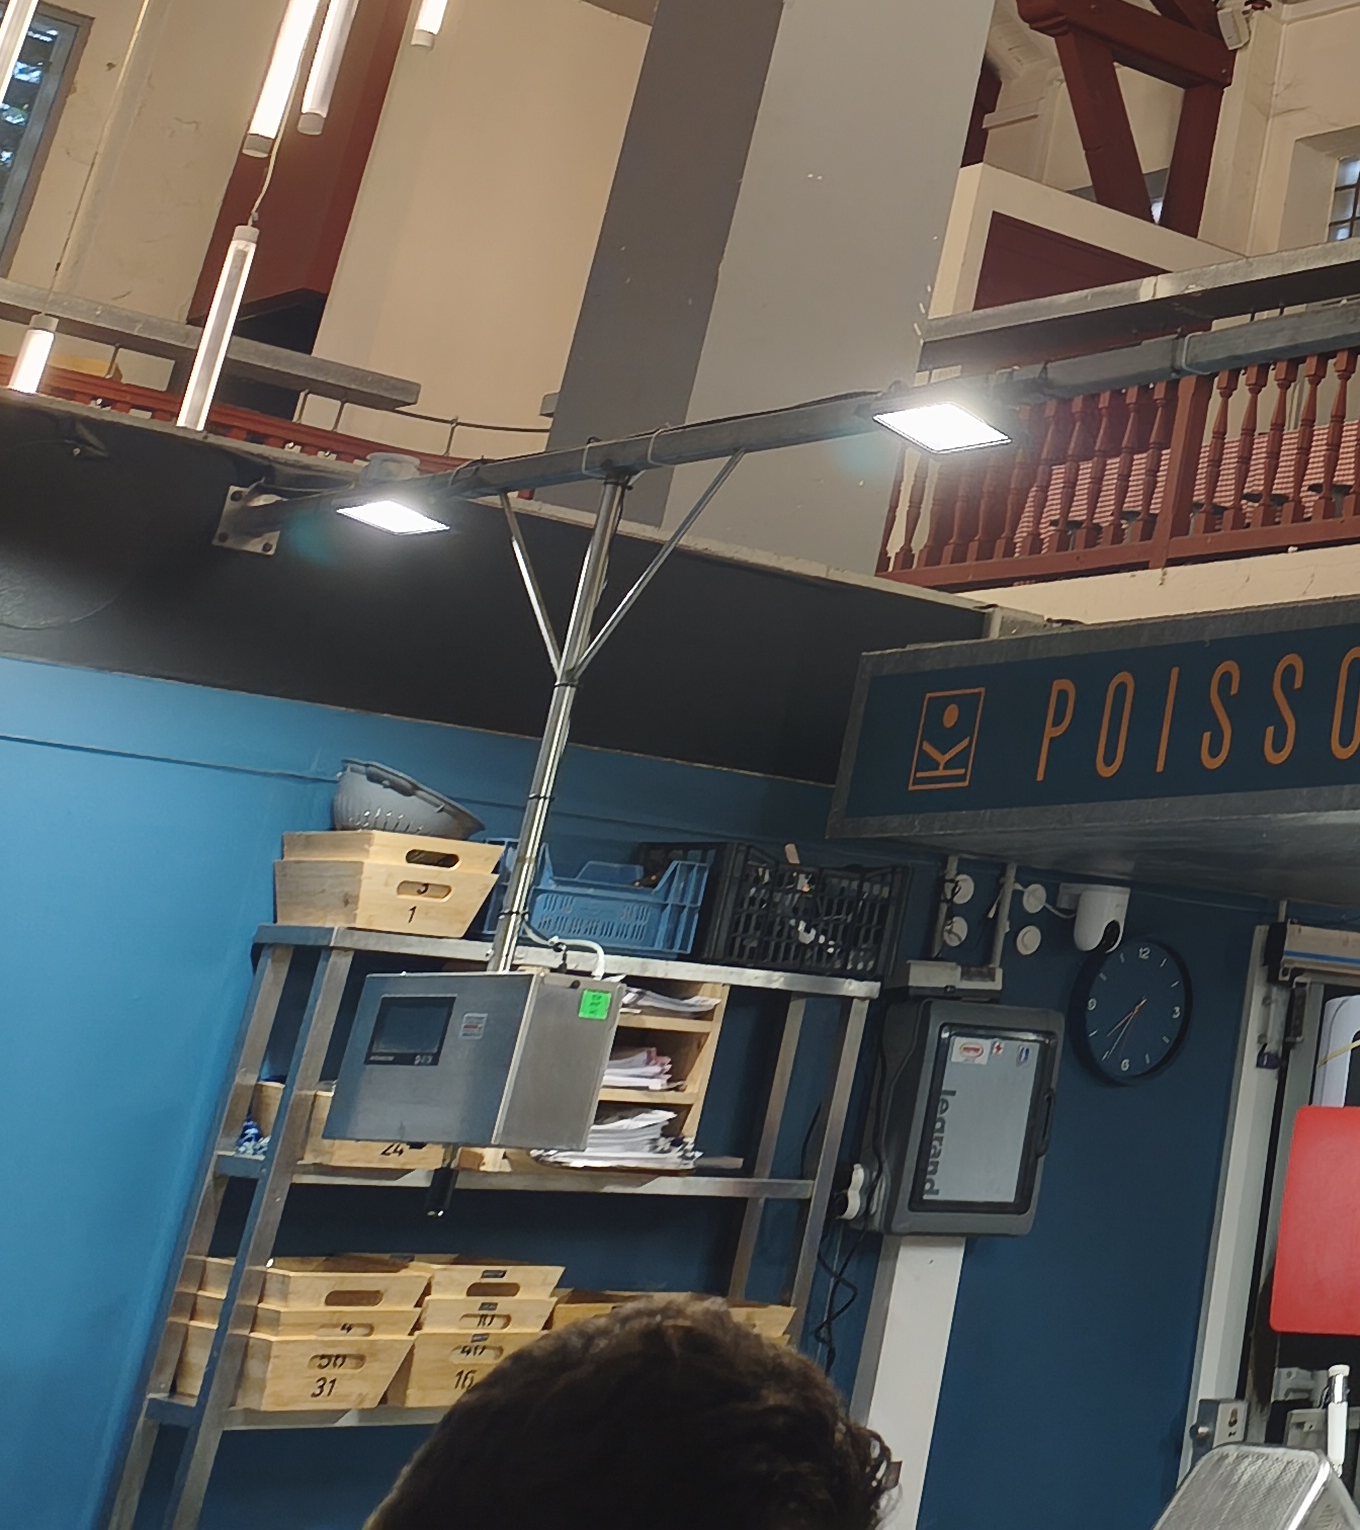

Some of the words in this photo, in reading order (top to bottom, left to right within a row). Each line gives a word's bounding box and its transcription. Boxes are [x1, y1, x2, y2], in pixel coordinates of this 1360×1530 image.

[1138, 947, 1151, 960] 12
[1172, 1006, 1181, 1019] 3
[923, 1089, 957, 1197] legrand
[311, 1376, 337, 1399] 31
